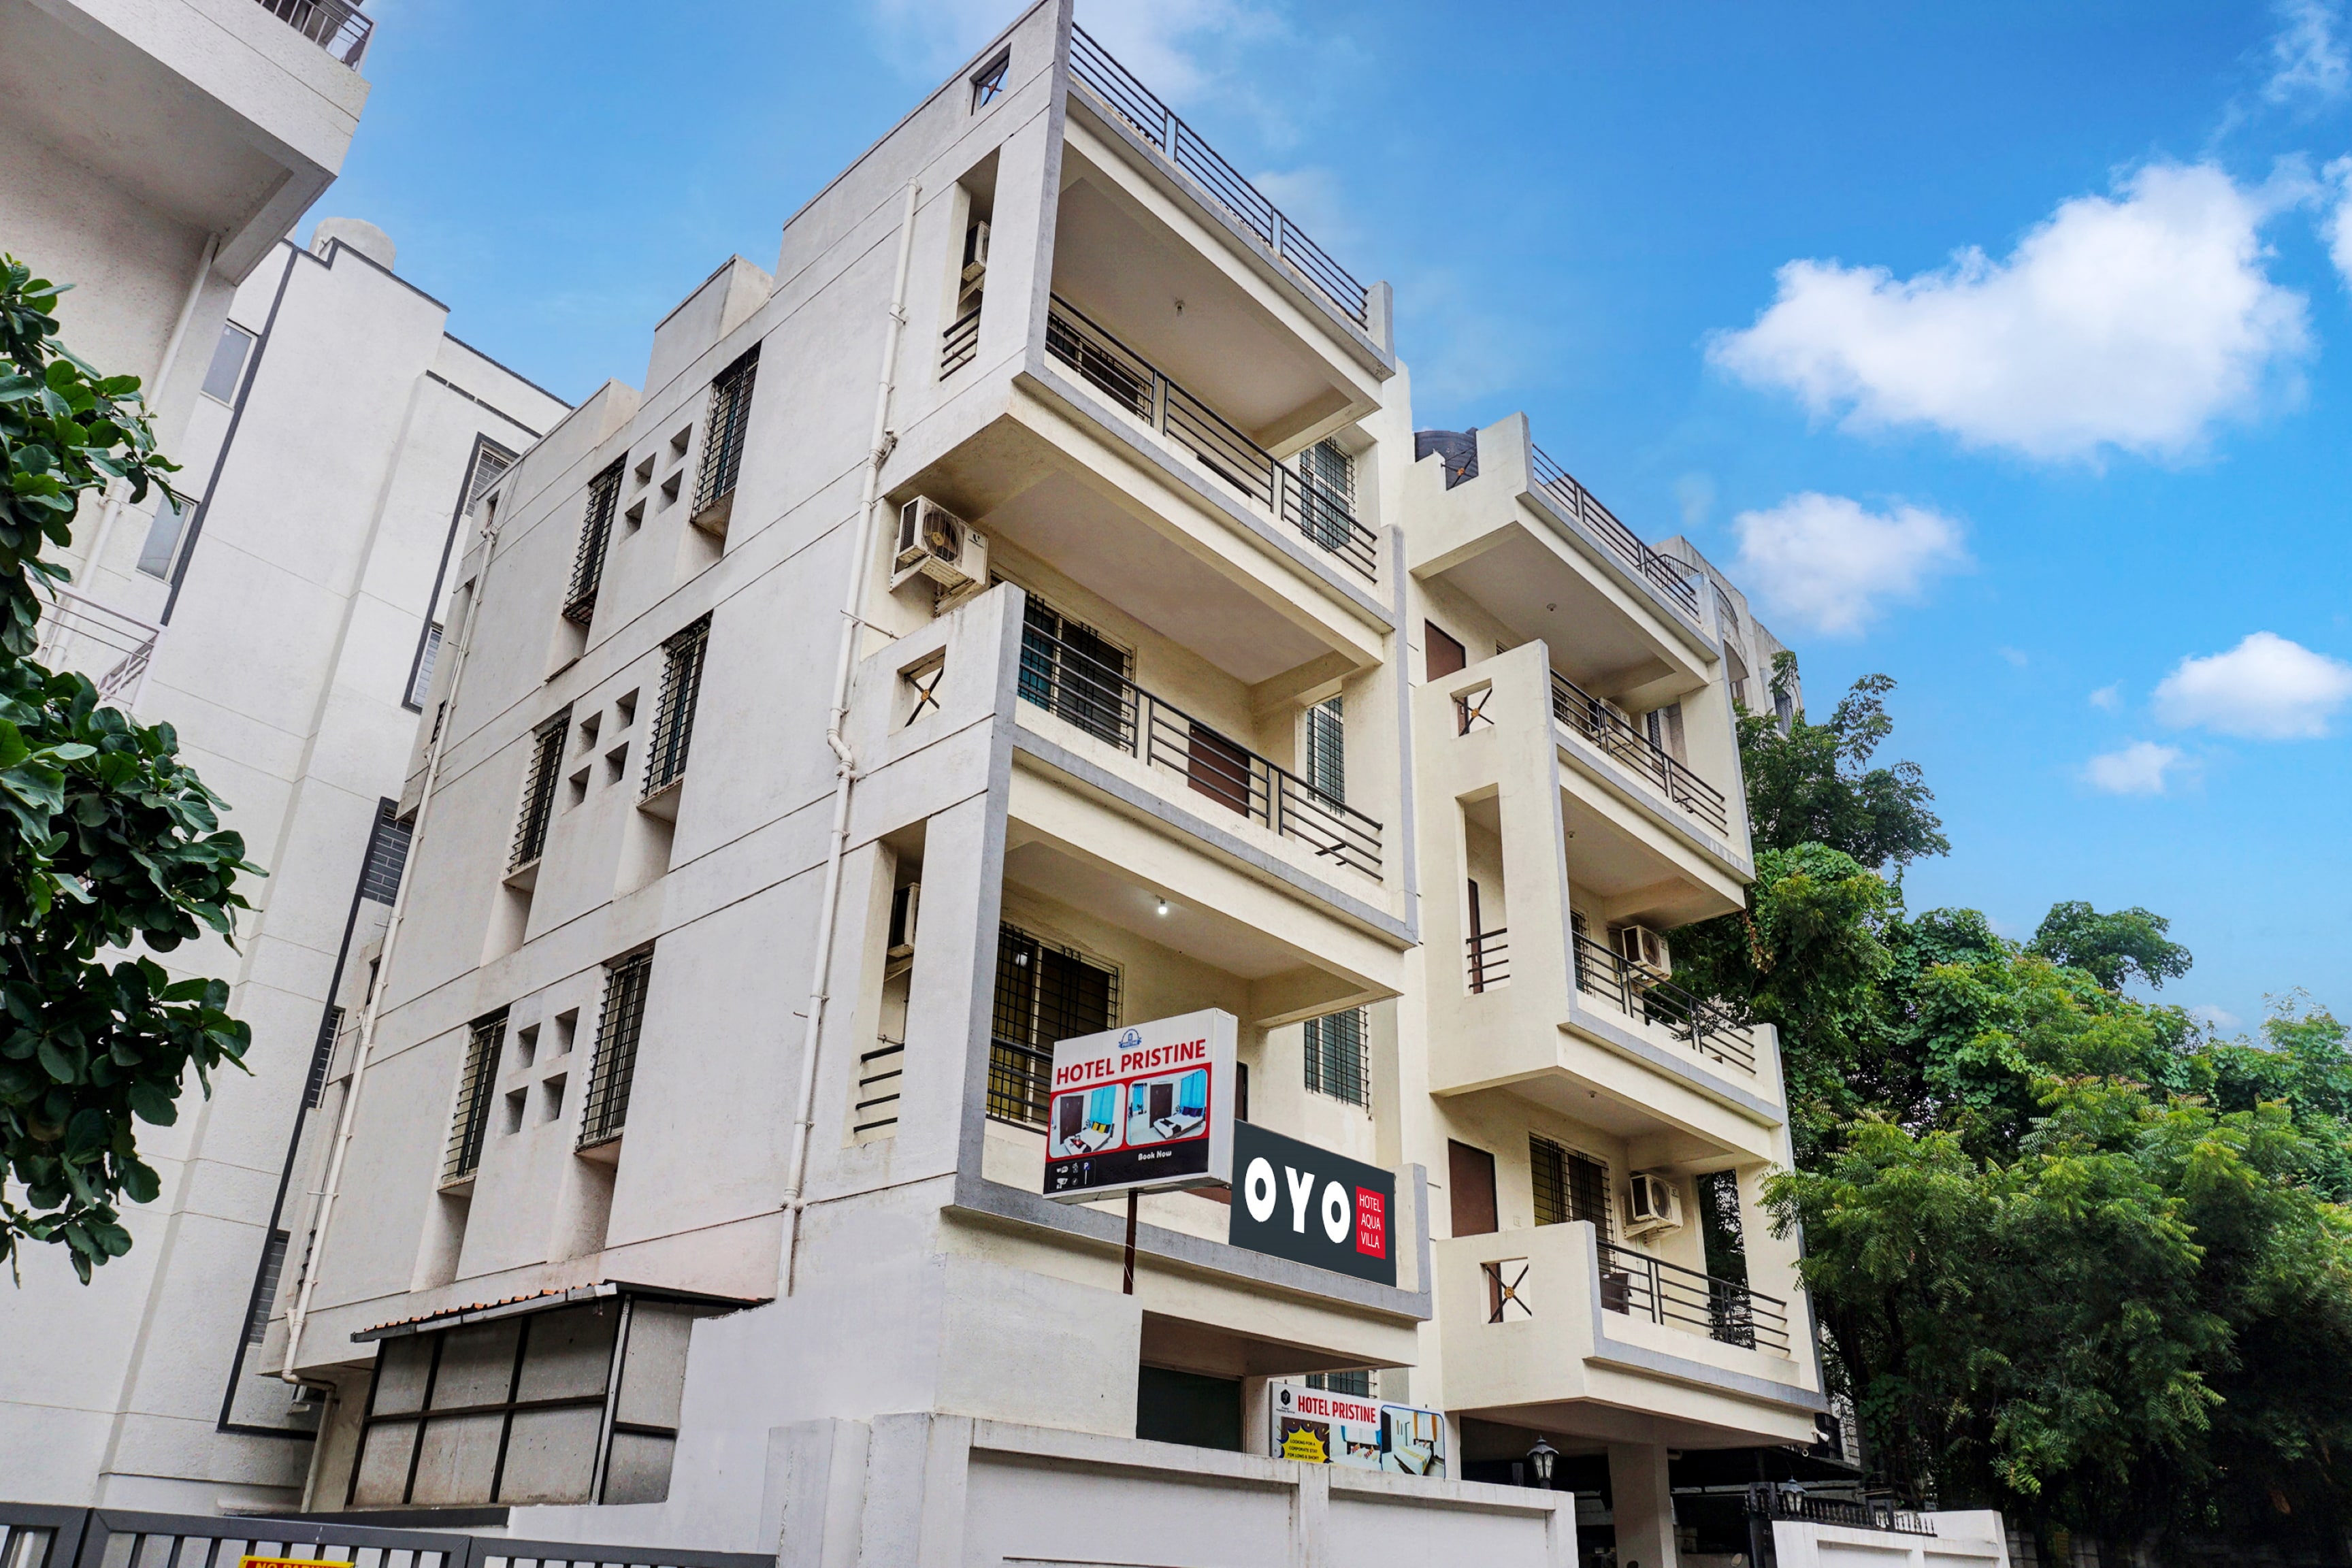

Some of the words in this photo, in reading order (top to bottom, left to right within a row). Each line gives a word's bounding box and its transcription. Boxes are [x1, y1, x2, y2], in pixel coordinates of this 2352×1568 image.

[1056, 1058, 1115, 1085] HOTEL
[1121, 1039, 1206, 1073] PRISTINE
[1138, 1152, 1155, 1161] Book
[1156, 1149, 1172, 1158] Now
[1245, 1157, 1350, 1244] OYO
[1359, 1194, 1382, 1213] HOTEL
[1361, 1213, 1381, 1231] AQUA
[1360, 1230, 1380, 1249] VILLA
[1298, 1394, 1330, 1416] HOTEL
[1332, 1401, 1376, 1424] PRISTINE
